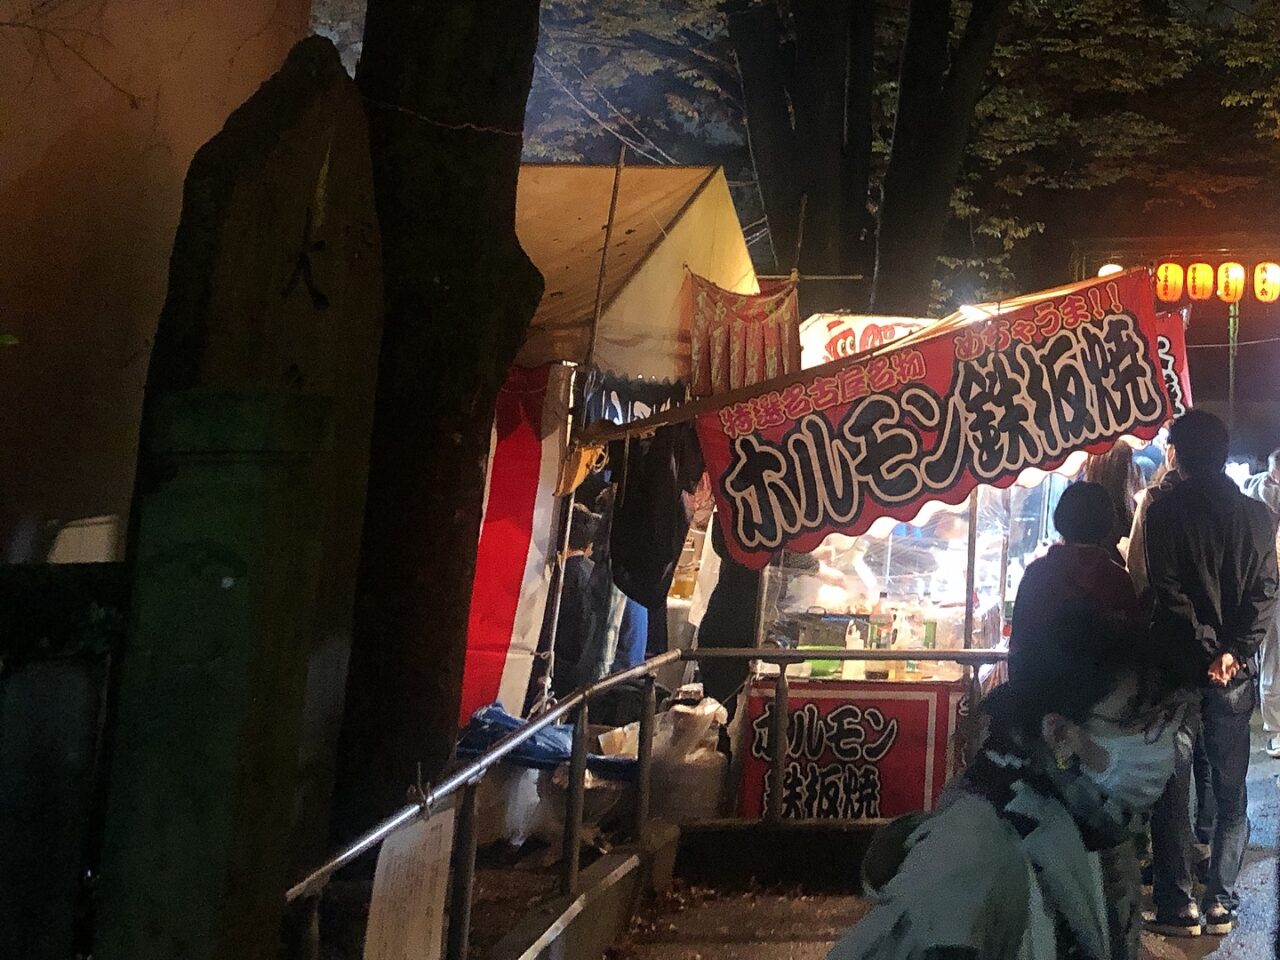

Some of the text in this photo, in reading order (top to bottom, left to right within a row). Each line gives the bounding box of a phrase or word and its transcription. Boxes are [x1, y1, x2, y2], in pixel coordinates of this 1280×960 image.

[724, 313, 1164, 549] ホルモン鉄板焼
